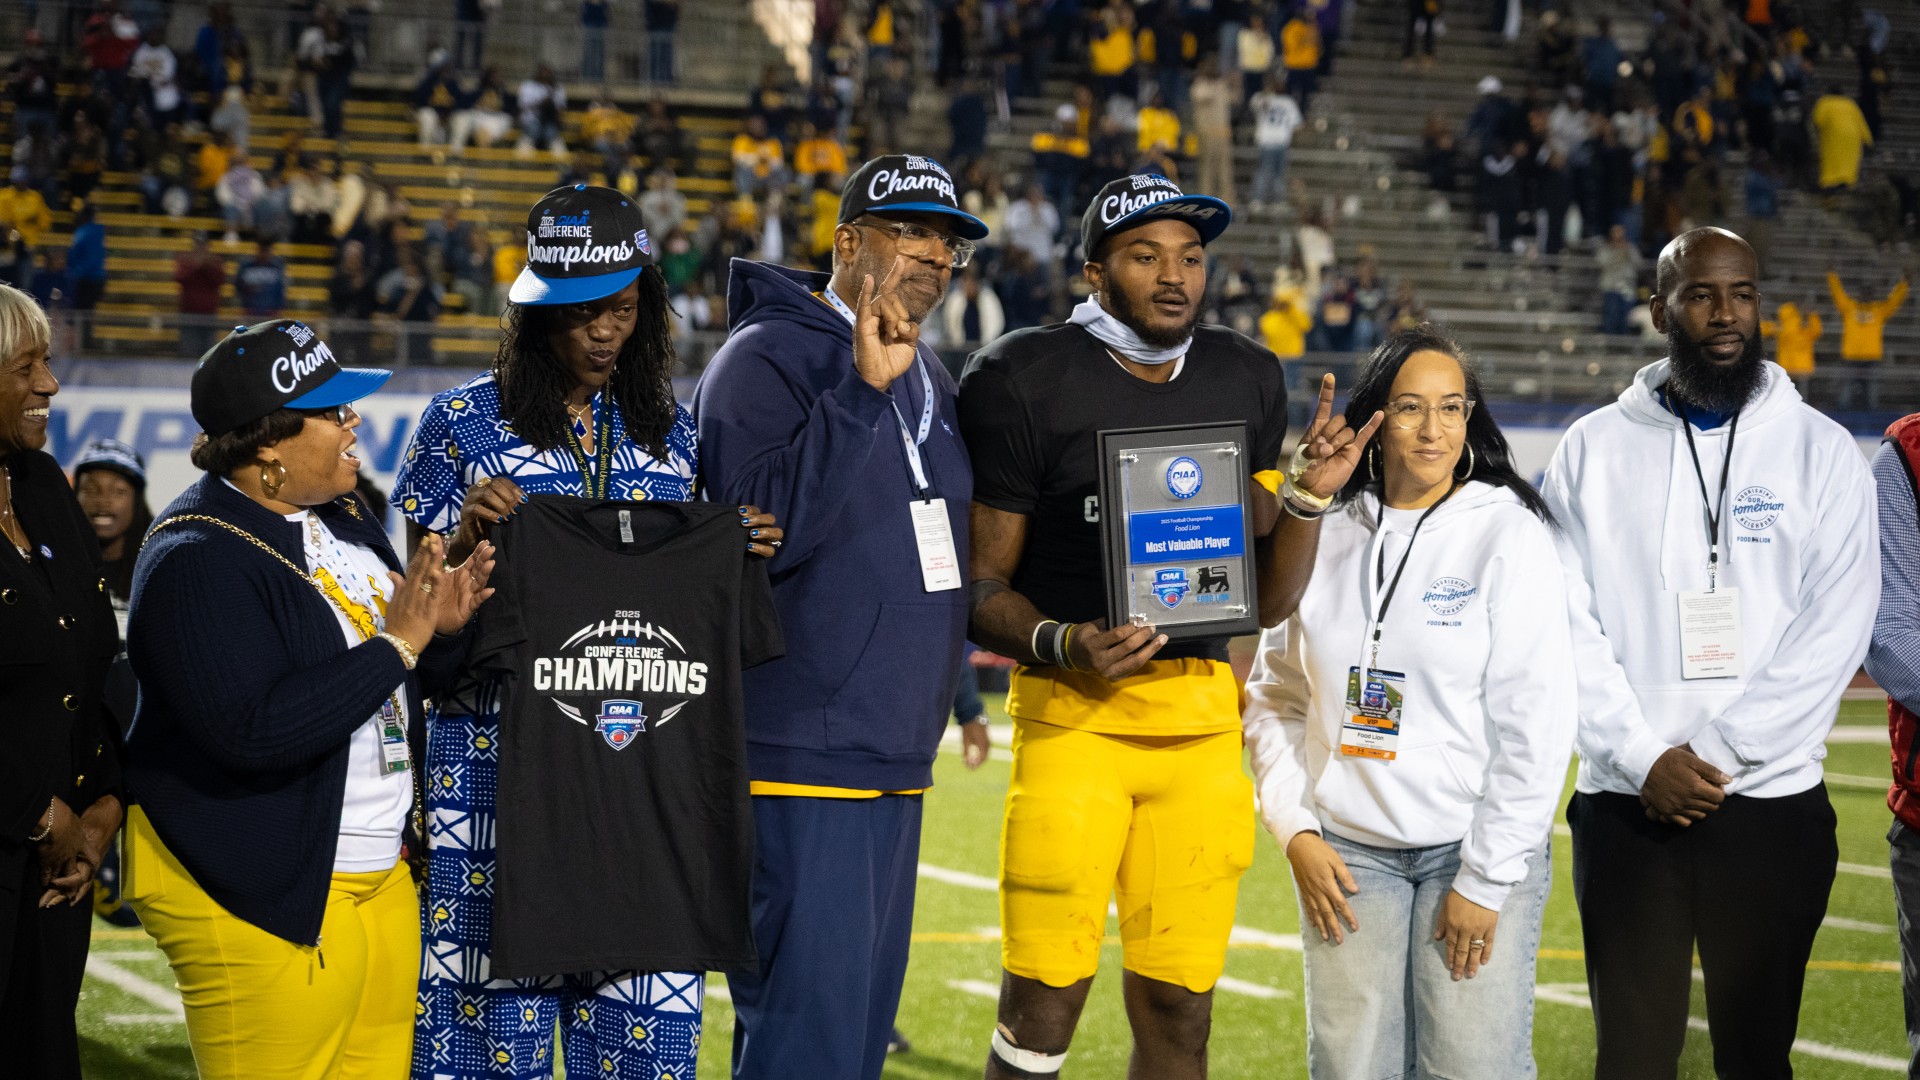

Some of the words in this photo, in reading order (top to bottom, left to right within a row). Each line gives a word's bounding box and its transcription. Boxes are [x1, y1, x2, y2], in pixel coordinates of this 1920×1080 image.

[1144, 203, 1219, 220] CIAA
[541, 216, 555, 226] 2025
[556, 215, 588, 225] CIAA
[538, 226, 592, 238] CONFERENCE
[601, 421, 610, 447] Johnson
[600, 453, 609, 471] Smith
[1172, 470, 1196, 479] CIAA
[1738, 488, 1774, 502] NOURISHING
[1186, 515, 1214, 523] Championship
[1740, 514, 1775, 529] NEIGHBORS
[1174, 524, 1188, 532] Food
[1145, 540, 1167, 553] Most
[1167, 537, 1203, 551] Valuable
[1204, 536, 1231, 550] Player
[1161, 572, 1180, 580] CIAA
[1422, 587, 1477, 602] Hometown
[614, 610, 641, 618] 2025
[615, 637, 638, 646] CIAA
[584, 646, 665, 660] CONFERENCE
[533, 657, 709, 696] CHAMPIONS
[609, 705, 634, 716] CIAA
[1367, 718, 1379, 726] VIP
